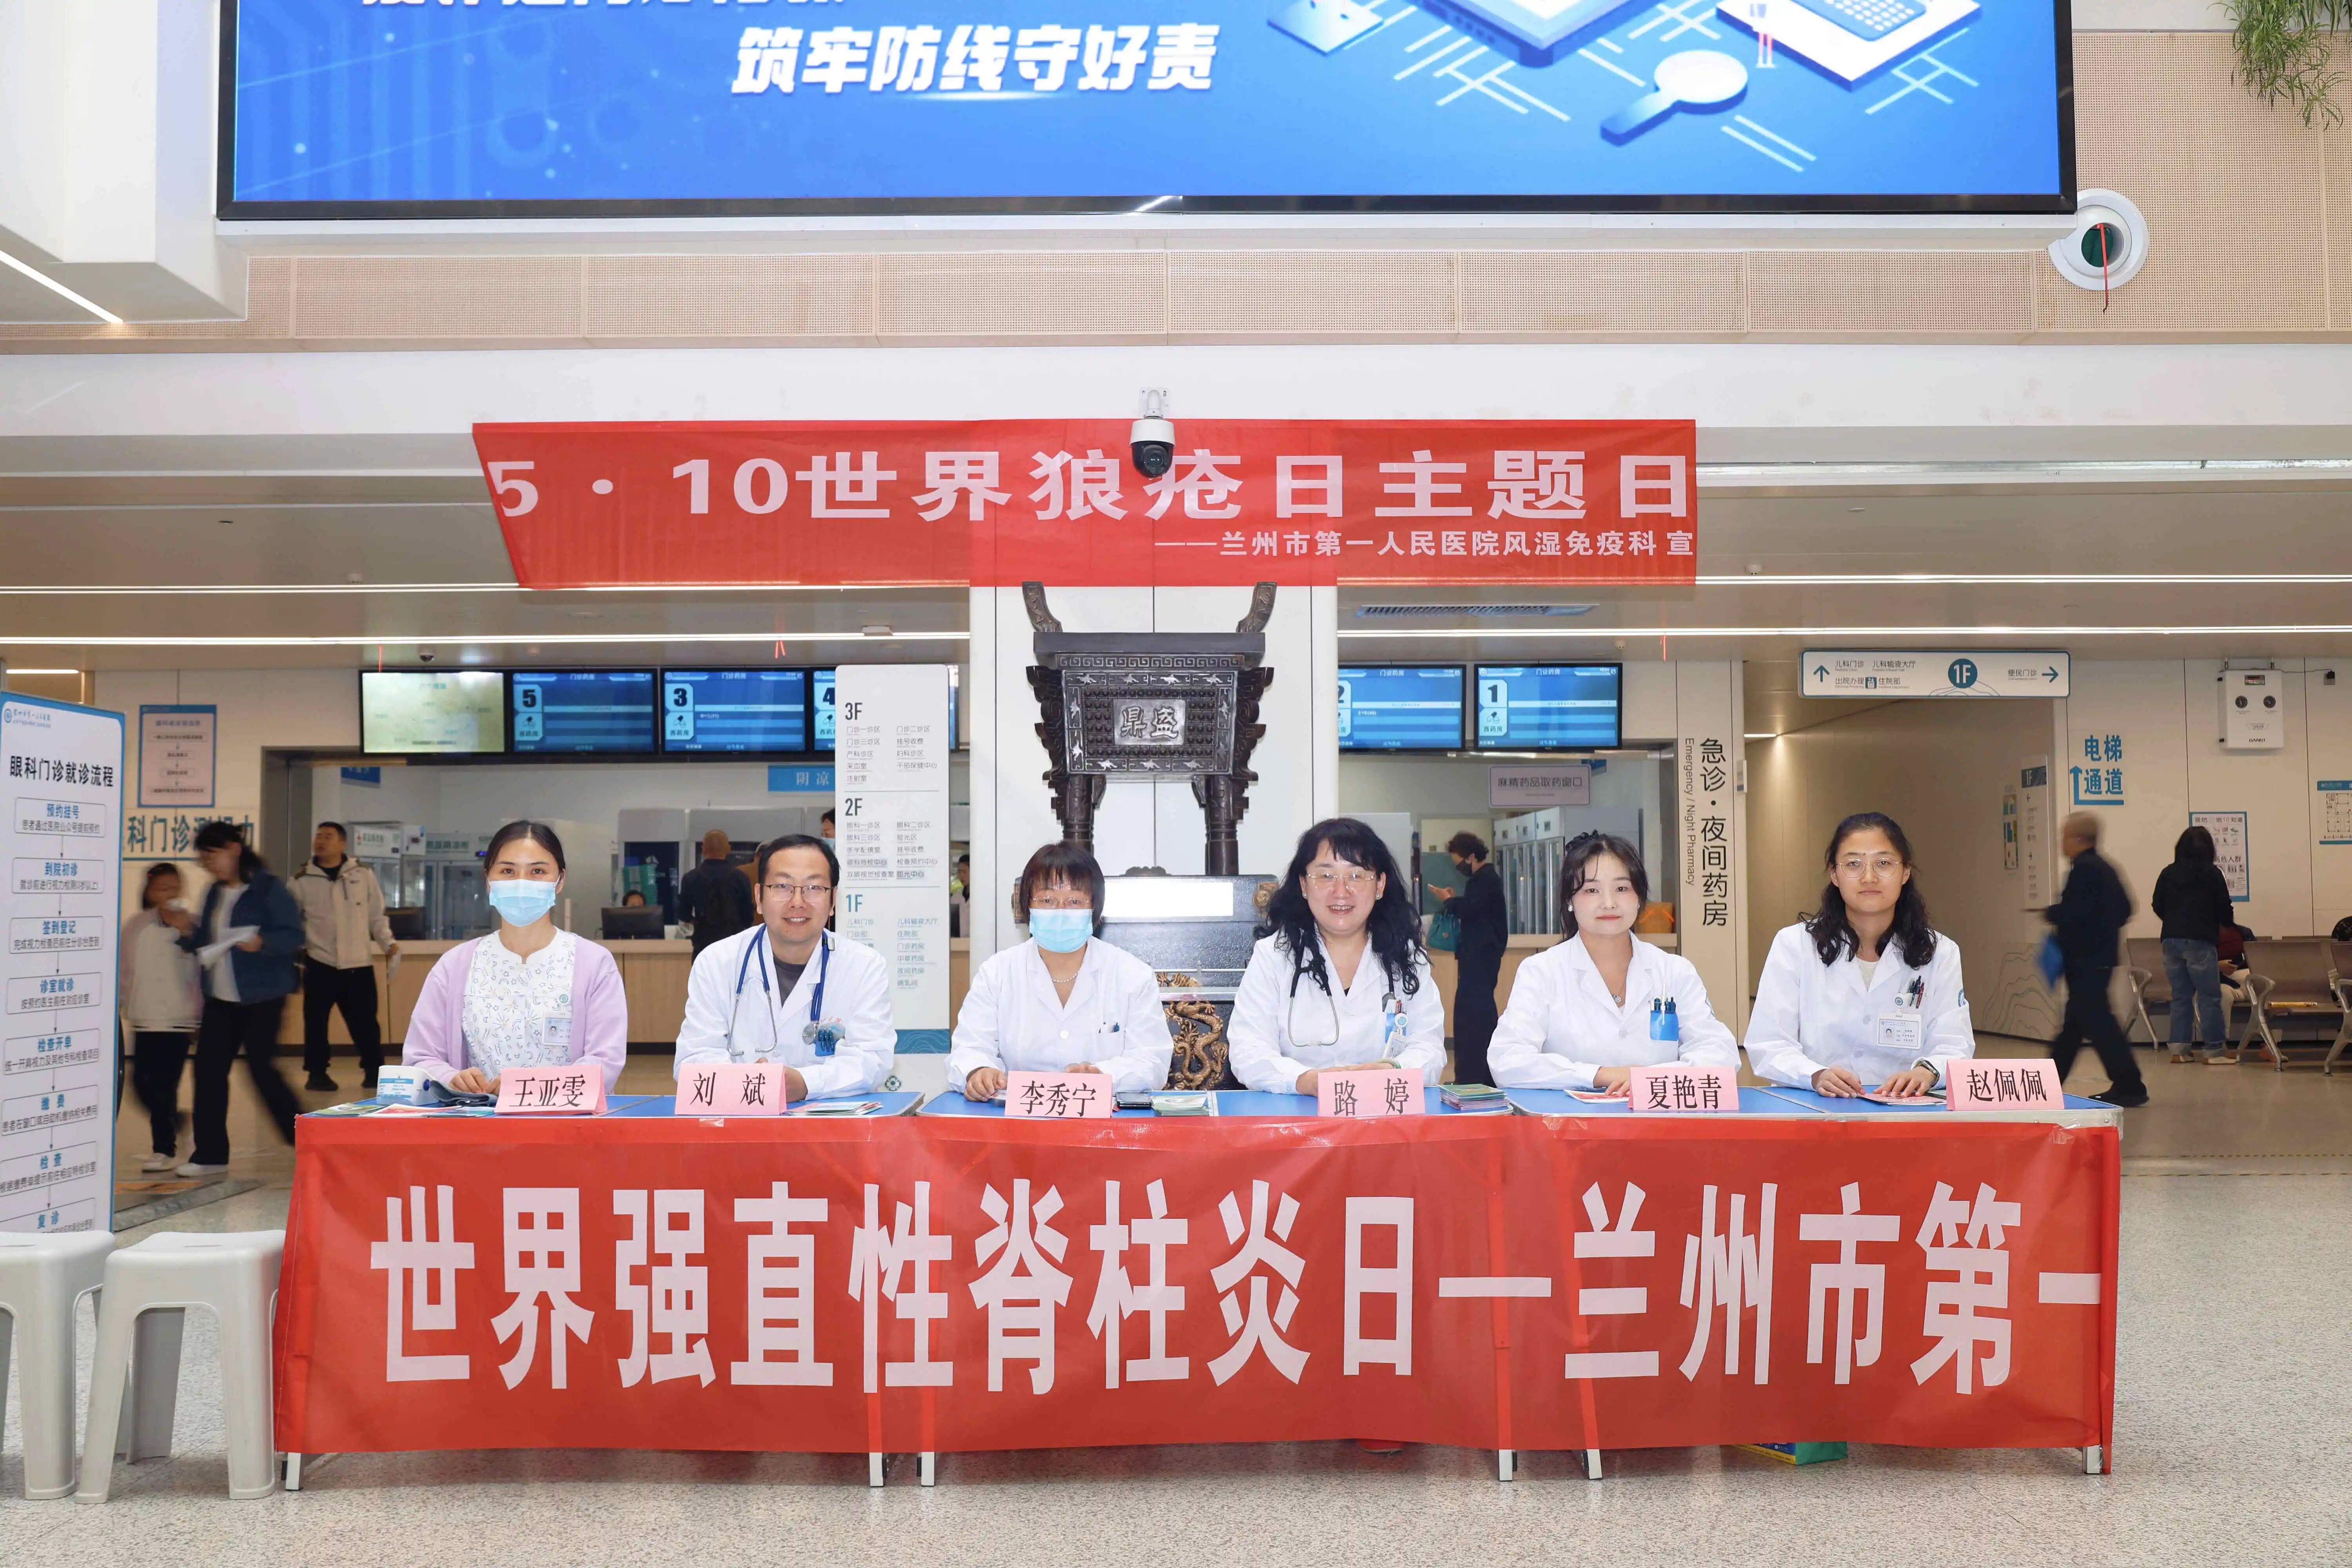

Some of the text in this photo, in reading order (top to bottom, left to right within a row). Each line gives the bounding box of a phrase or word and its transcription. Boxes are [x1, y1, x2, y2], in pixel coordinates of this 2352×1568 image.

[732, 24, 1220, 95] 筑牢防线守好责
[1666, 530, 1694, 557] 宣
[1954, 664, 1971, 684] 1F
[523, 689, 536, 707] 5
[673, 688, 688, 706] 3
[822, 688, 835, 705] 4
[1488, 684, 1498, 702] 1
[845, 702, 863, 720] 3F
[2084, 734, 2122, 762] 电梯
[10, 755, 113, 787] 眼科门诊就诊流程
[1684, 738, 1694, 795] Emergency
[1498, 777, 1582, 788] 麻精药品取药窗口
[2084, 768, 2123, 795] 通道
[47, 804, 80, 819] 预约挂号
[845, 798, 863, 816] 2F
[1684, 805, 1696, 832] Night
[122, 814, 254, 853] 科门诊力
[45, 862, 78, 877] 到院初诊
[1685, 834, 1696, 886] Pharmacy
[846, 894, 863, 912] 1F
[43, 920, 76, 935] 签到登记
[40, 978, 74, 993] 诊室就诊
[38, 1035, 72, 1053] 检查开单
[509, 1074, 586, 1108] 王亚雯
[1646, 1074, 1722, 1110] 夏艳青
[1966, 1068, 2047, 1102] 赵佩佩
[1020, 1080, 1096, 1117] 李秀宁
